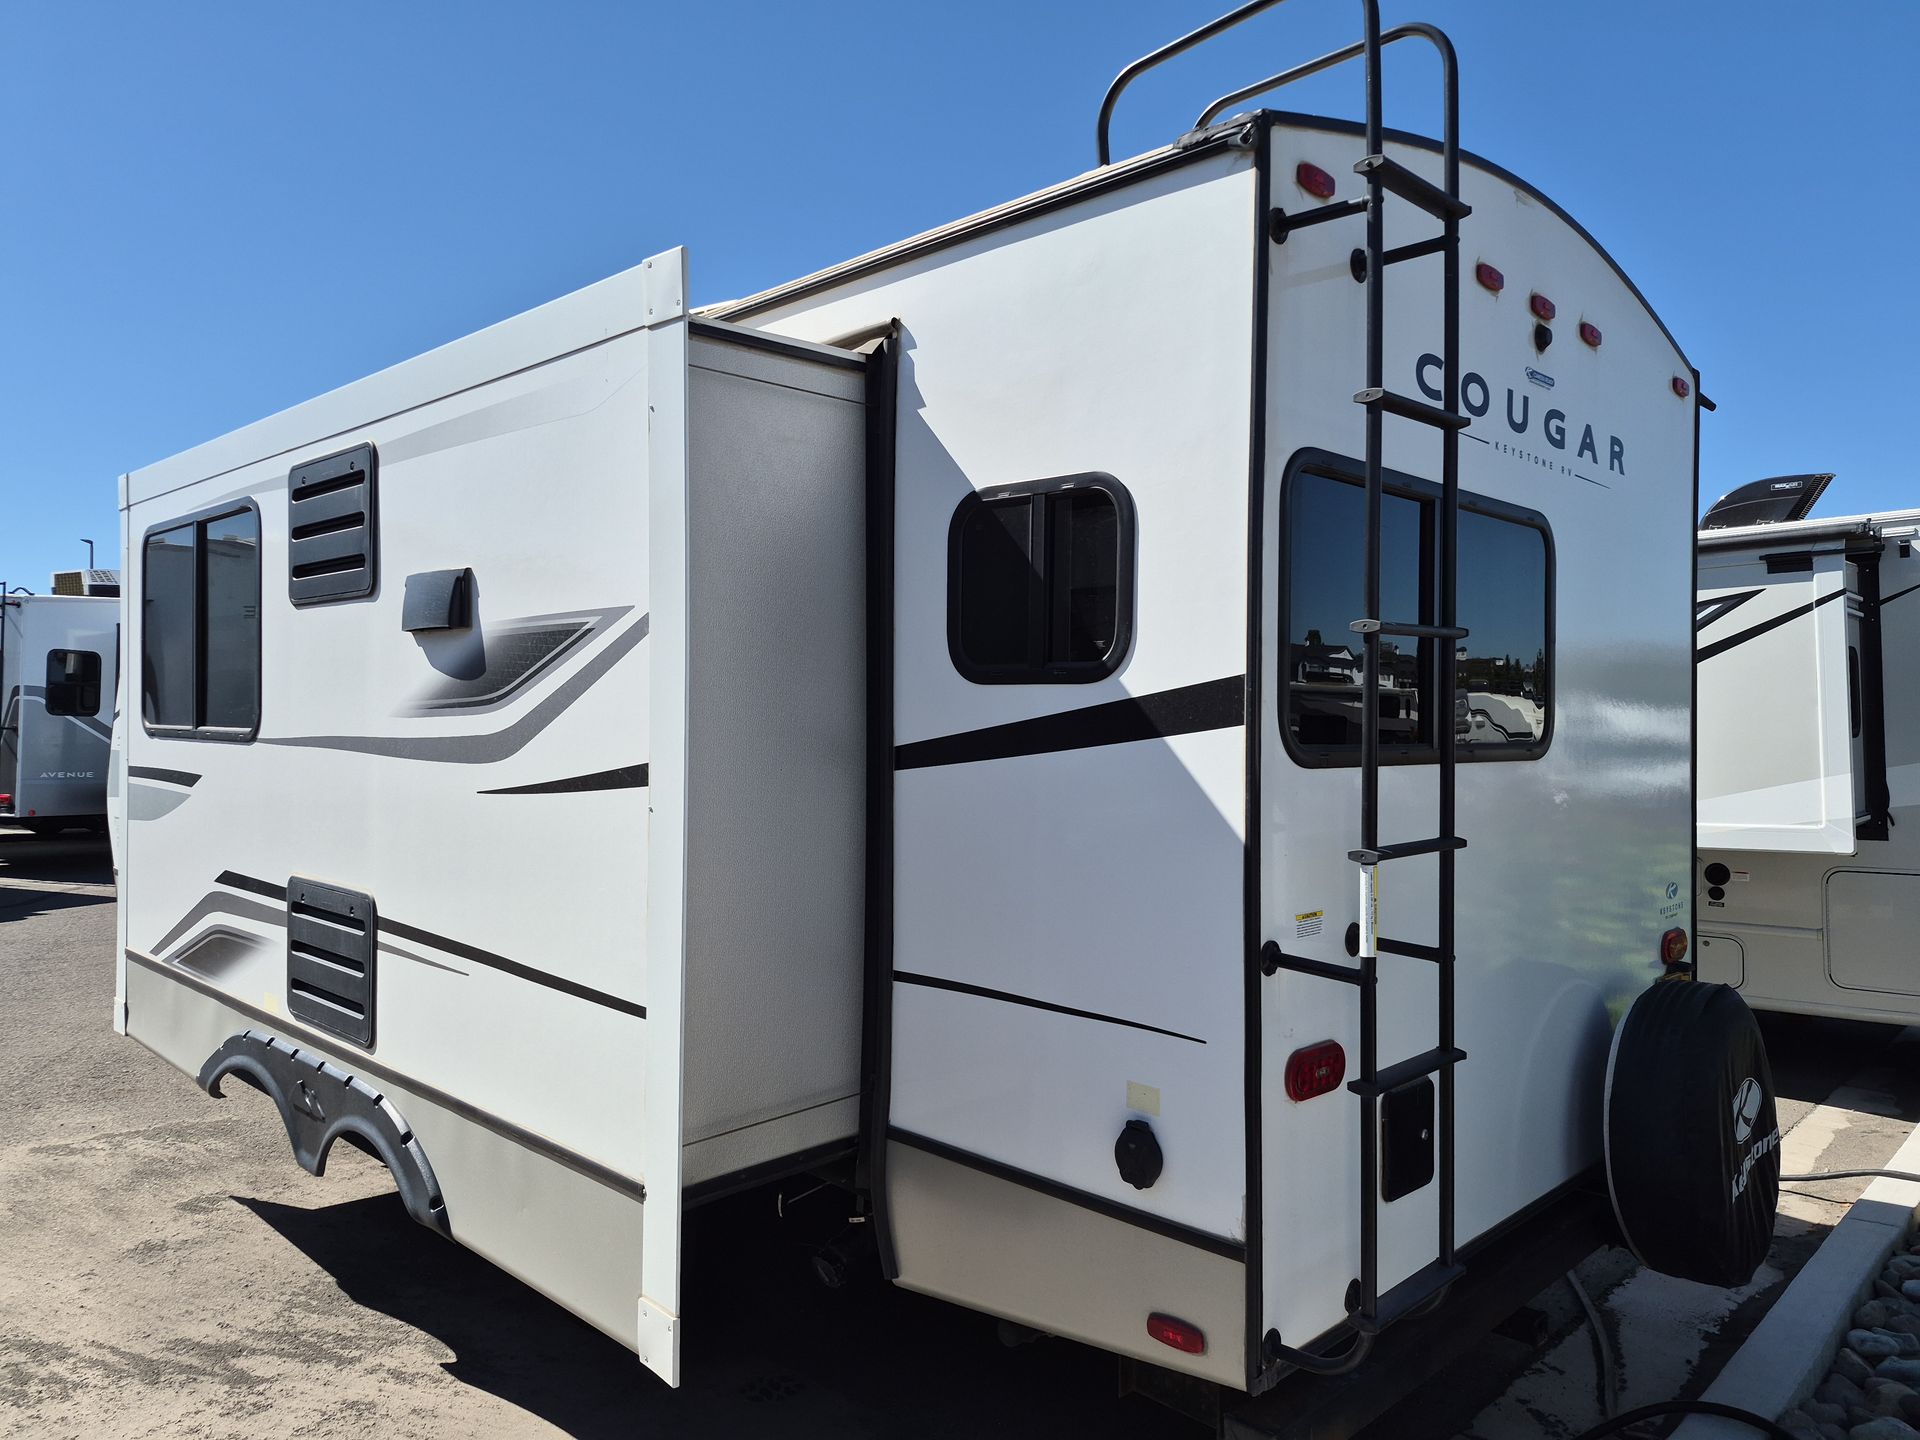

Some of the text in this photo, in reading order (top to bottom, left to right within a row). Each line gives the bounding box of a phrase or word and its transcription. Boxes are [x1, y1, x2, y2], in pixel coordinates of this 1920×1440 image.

[1415, 353, 1626, 476] COUGAR
[1494, 440, 1572, 477] KEYSTONE RV
